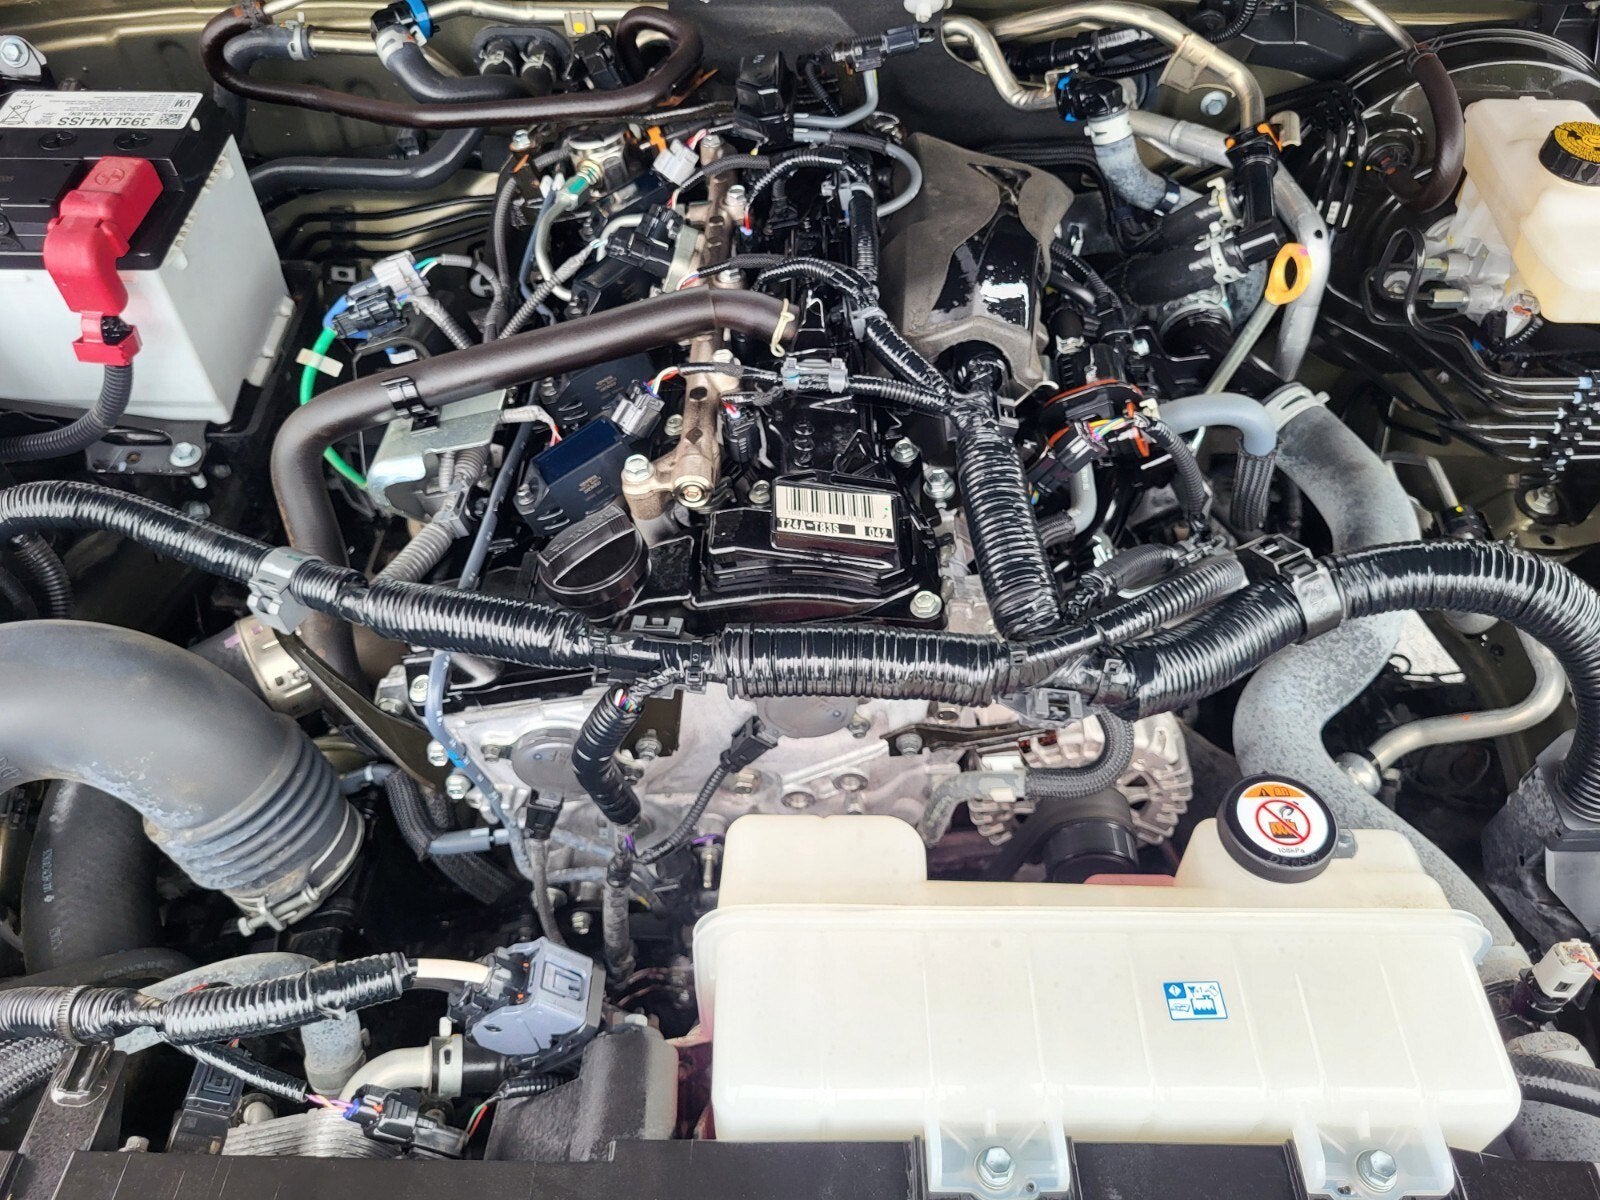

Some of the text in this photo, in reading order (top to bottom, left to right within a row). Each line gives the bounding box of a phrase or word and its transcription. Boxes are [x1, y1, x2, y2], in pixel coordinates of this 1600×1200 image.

[174, 99, 191, 108] VM
[57, 116, 151, 127] 395LN4-ISS
[780, 518, 840, 534] T24A-T83S
[868, 527, 888, 538] 042
